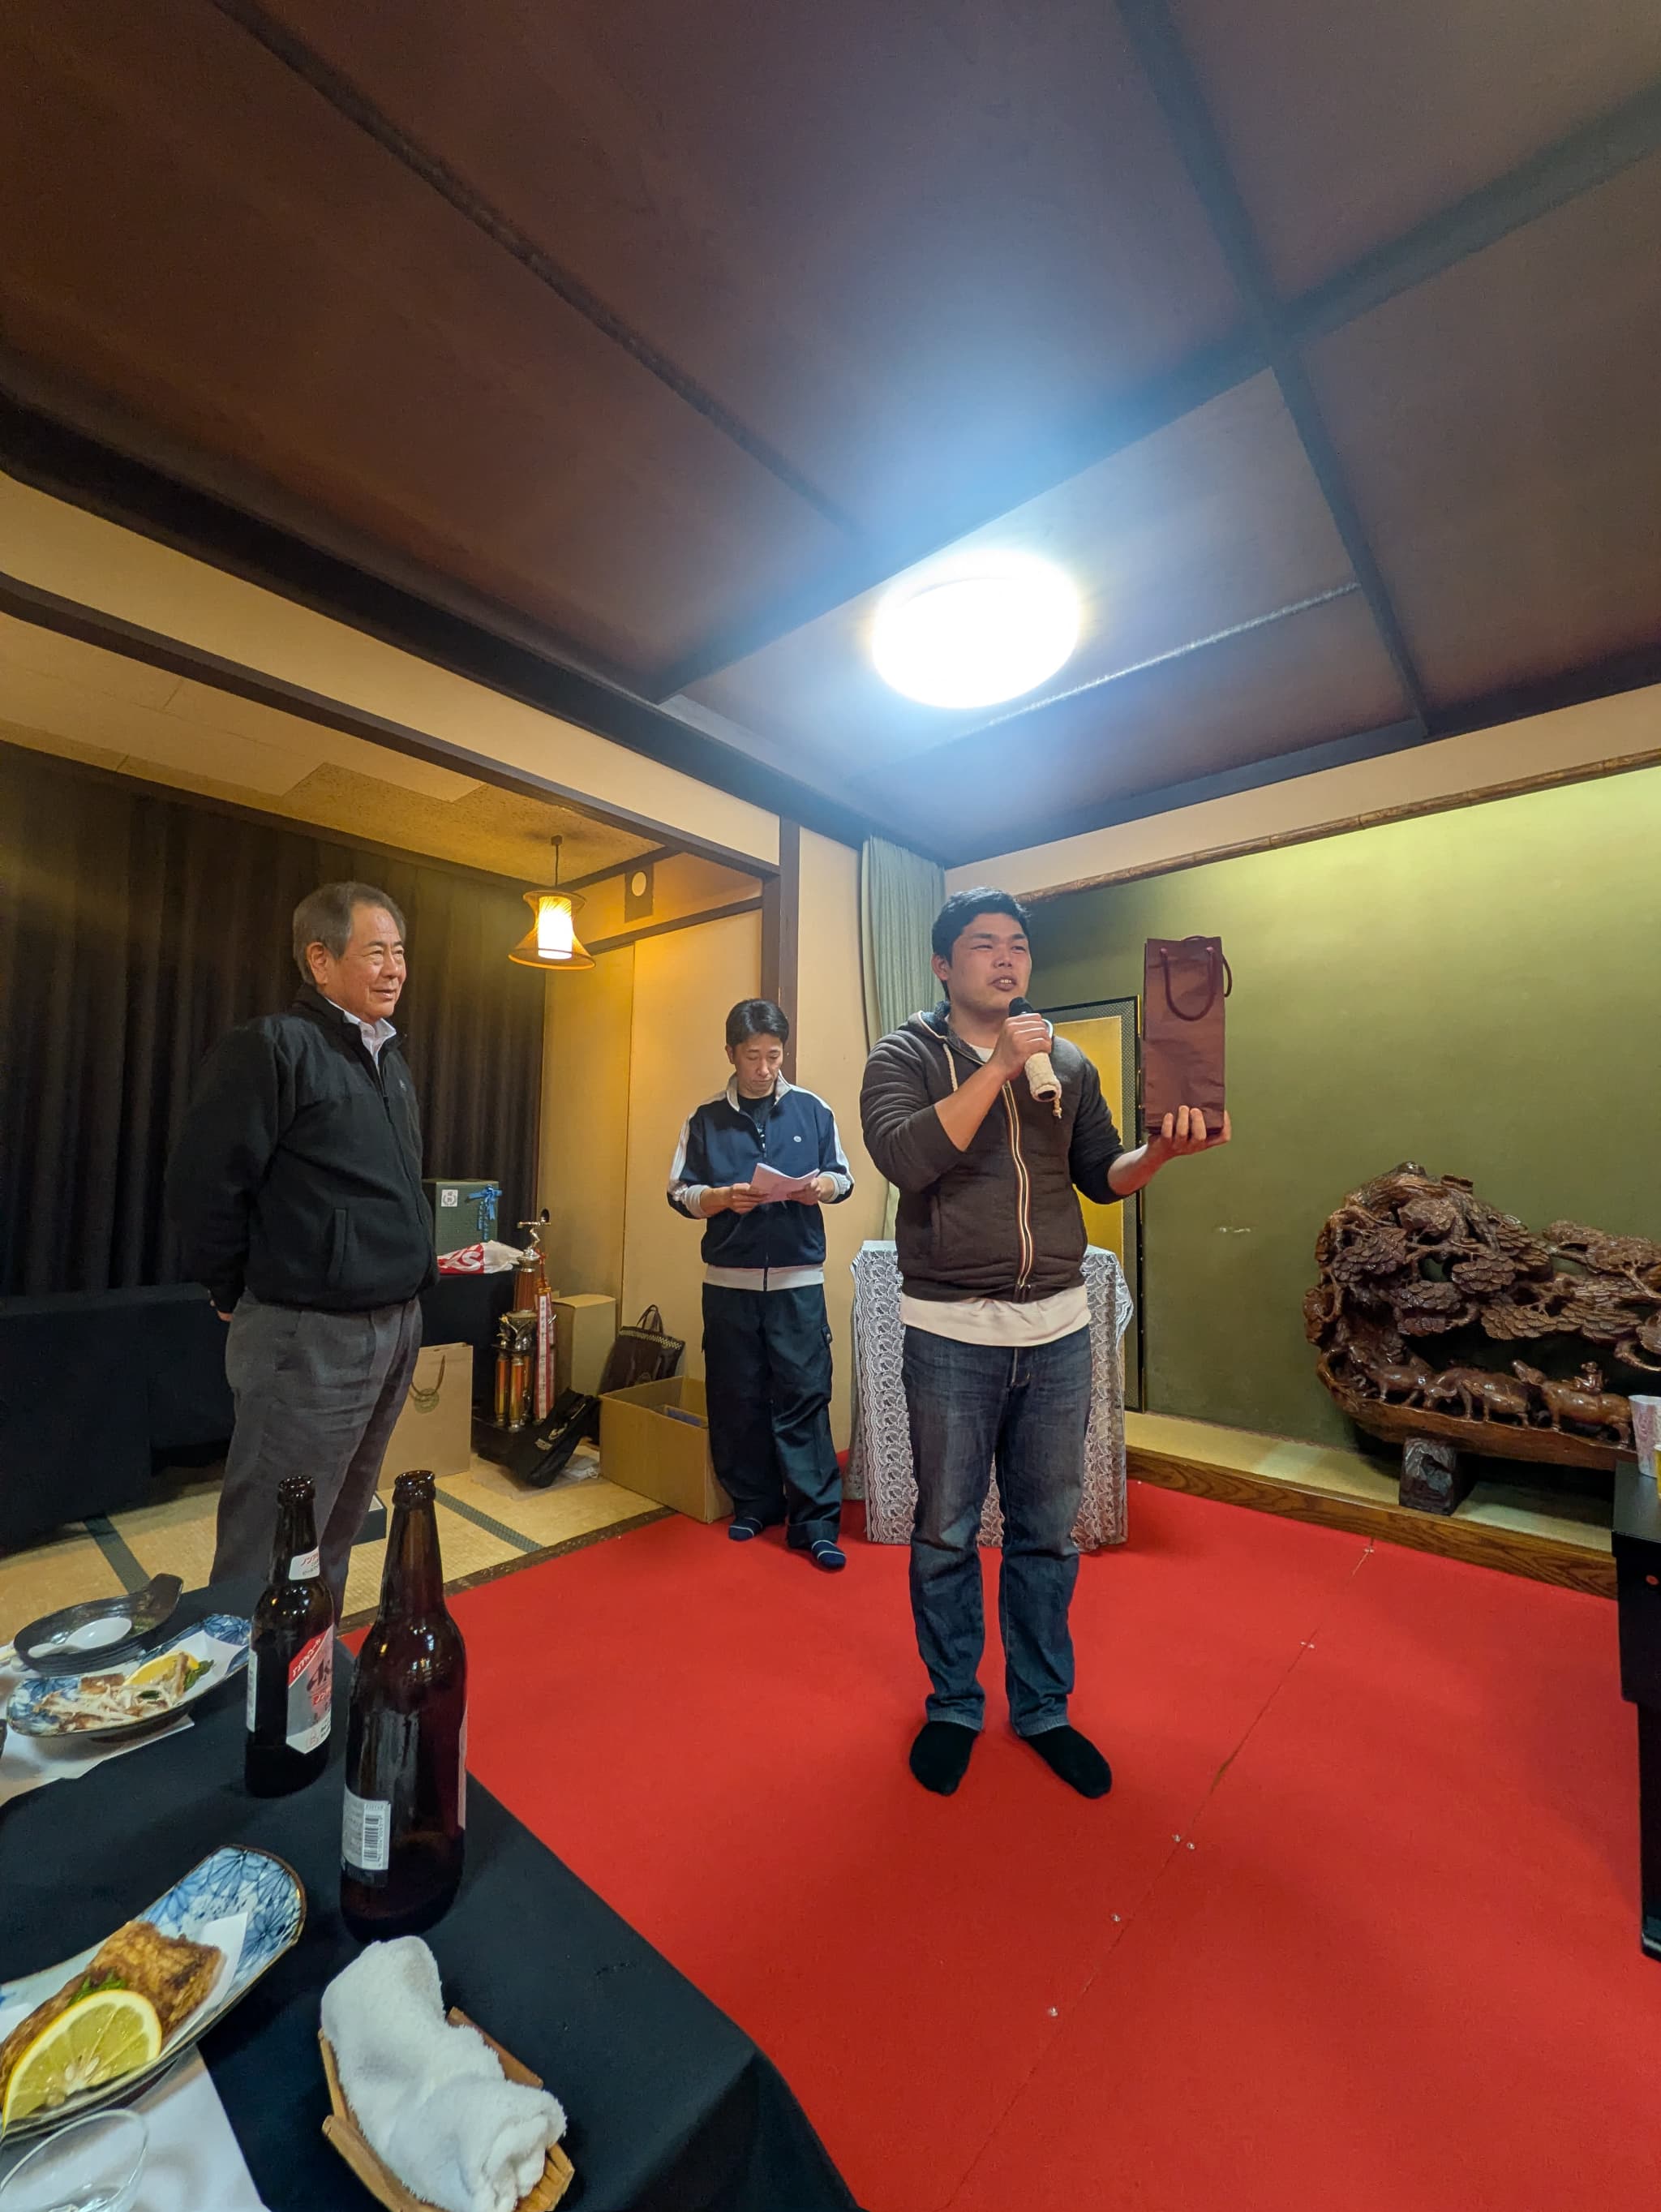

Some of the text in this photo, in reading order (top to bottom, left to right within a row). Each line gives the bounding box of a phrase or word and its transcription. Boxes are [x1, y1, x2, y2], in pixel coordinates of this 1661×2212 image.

[292, 1637, 322, 1678] ノンアルコール
